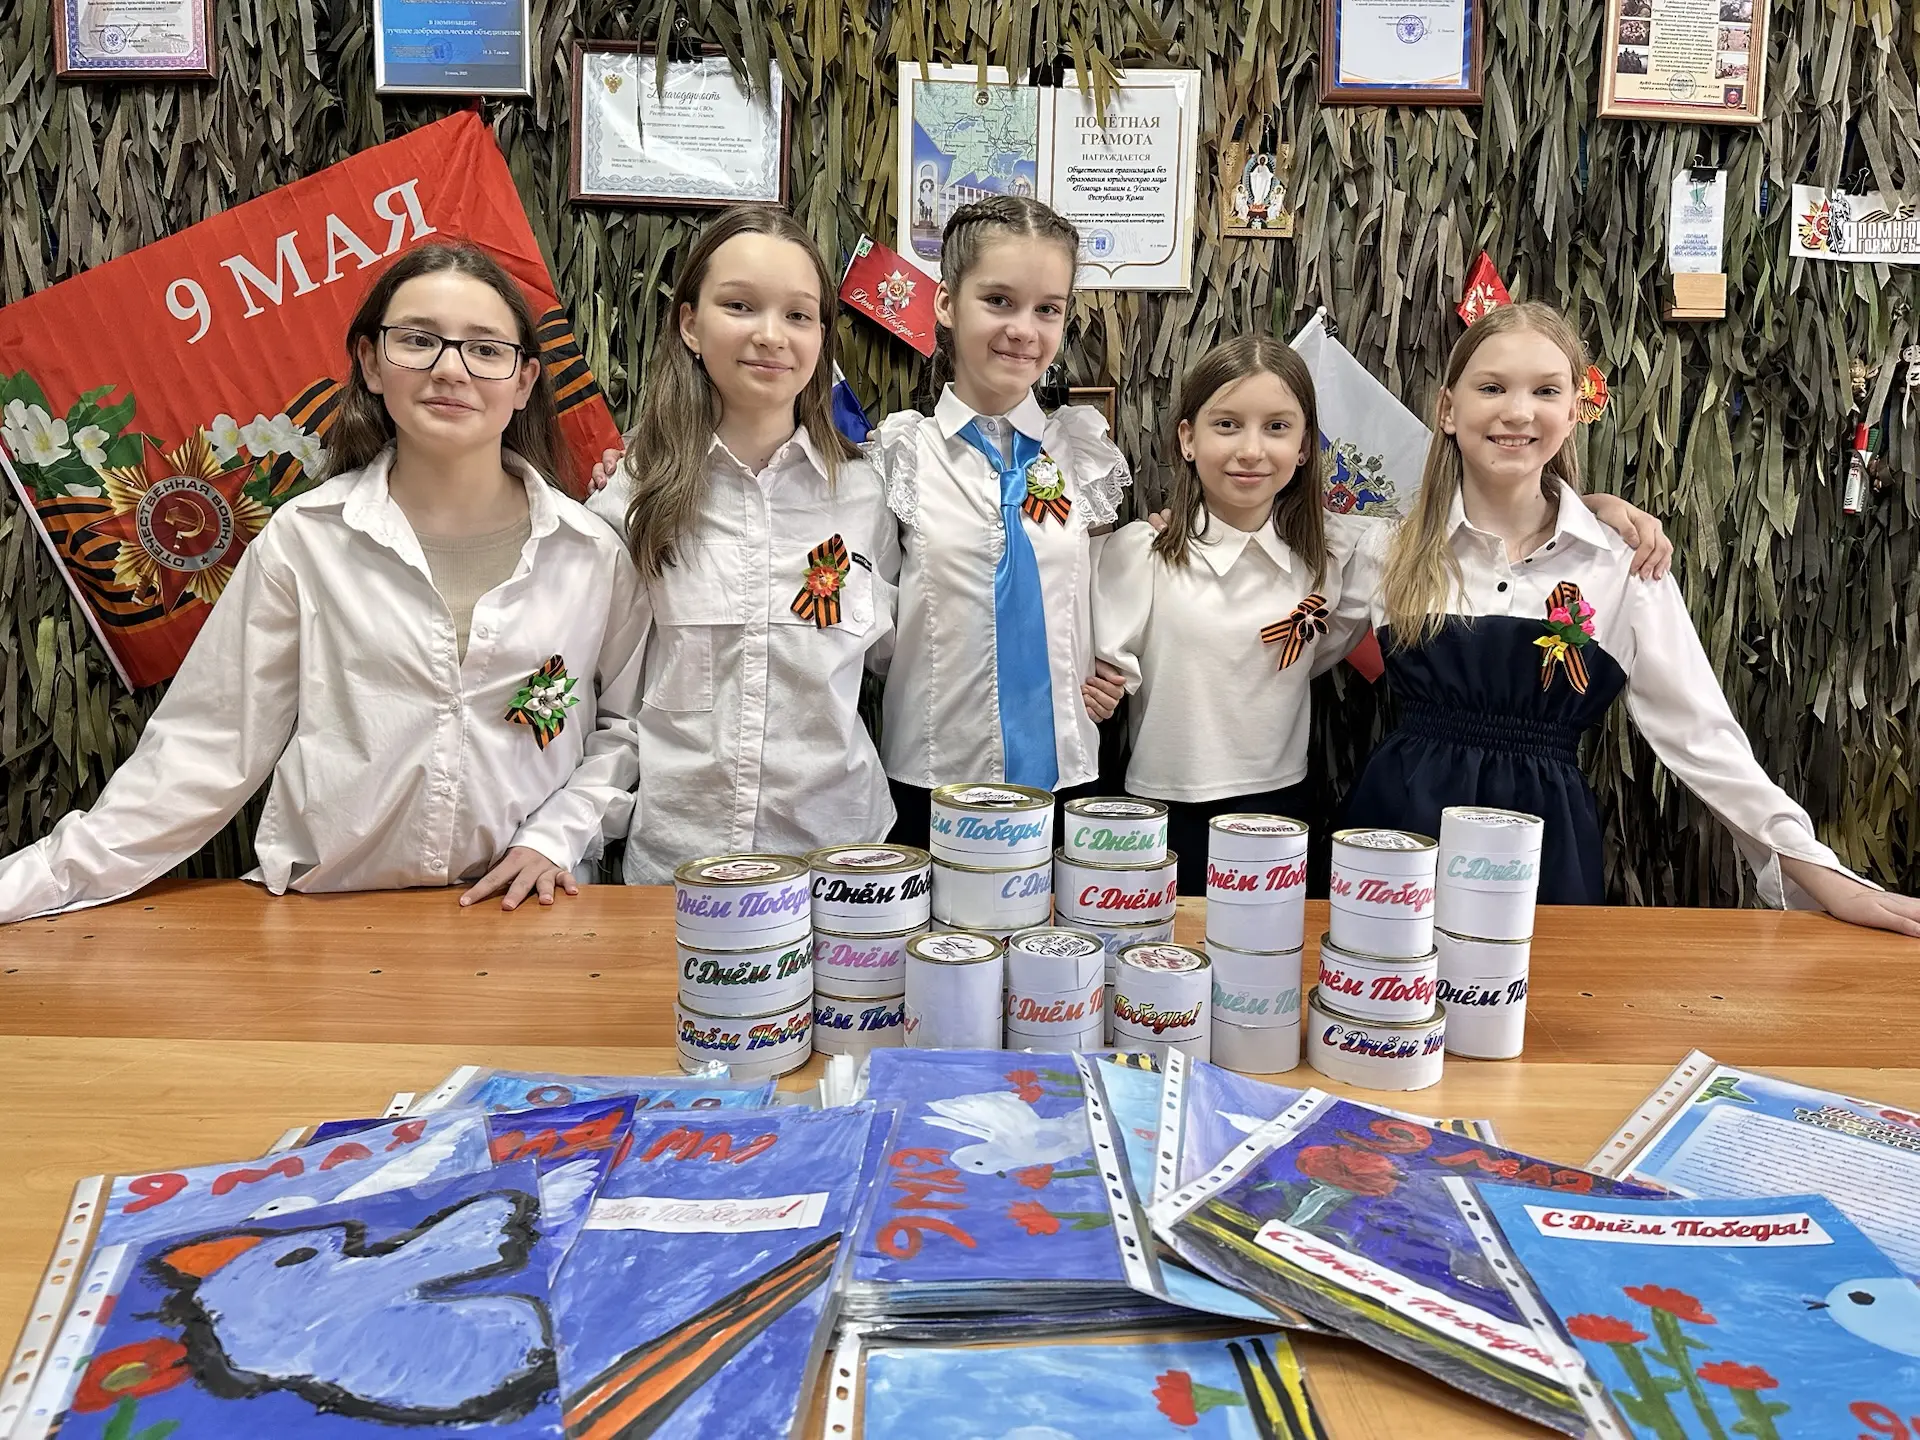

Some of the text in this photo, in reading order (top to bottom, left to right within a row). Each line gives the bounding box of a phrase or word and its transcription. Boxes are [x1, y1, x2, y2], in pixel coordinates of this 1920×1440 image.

[1081, 134, 1153, 146] ГРАМОТА
[1067, 166, 1167, 176] Общественная организация без
[1082, 154, 1150, 162] НАГРАЖДАЕТСЯ
[1066, 174, 1167, 184] образования юридического лица
[1072, 184, 1102, 193] «Помощь
[1088, 194, 1144, 203] Республики Коми
[1842, 221, 1858, 253] Я
[1858, 221, 1916, 240] ПОМНЮ
[1857, 238, 1917, 254] ГОРЖУСЬ
[165, 177, 438, 345] 9 МАЯ
[849, 288, 926, 339] День Победы!
[139, 479, 210, 568] ОТЕЧЕСТВЕННАЯ
[930, 808, 1048, 847] ём Победы!
[1074, 826, 1155, 852] С Днём
[1206, 863, 1259, 892] Днём
[1447, 855, 1533, 882] С Днём
[812, 876, 827, 900] С
[826, 879, 896, 904] Днём
[1001, 875, 1022, 899] С
[1079, 885, 1100, 907] С
[1097, 886, 1162, 910] Днём
[677, 888, 733, 918] Днём
[814, 940, 830, 962] С
[828, 943, 900, 968] Днём
[684, 957, 698, 980] С
[696, 960, 772, 986] Днём
[1319, 960, 1363, 996] Днём
[1435, 979, 1503, 1006] Днём
[814, 1006, 854, 1031] нём
[1008, 994, 1017, 1016] С
[1016, 998, 1085, 1024] Днём
[1113, 993, 1203, 1035] Победы!
[681, 1020, 742, 1051] Днём
[1322, 1024, 1344, 1046] С
[1339, 1030, 1419, 1060] Днём
[123, 1173, 188, 1214] 9
[876, 1215, 977, 1261] 9
[1542, 1211, 1810, 1242] С Днём Победы!
[1265, 1230, 1303, 1243] С
[1293, 1244, 1403, 1296] Днём
